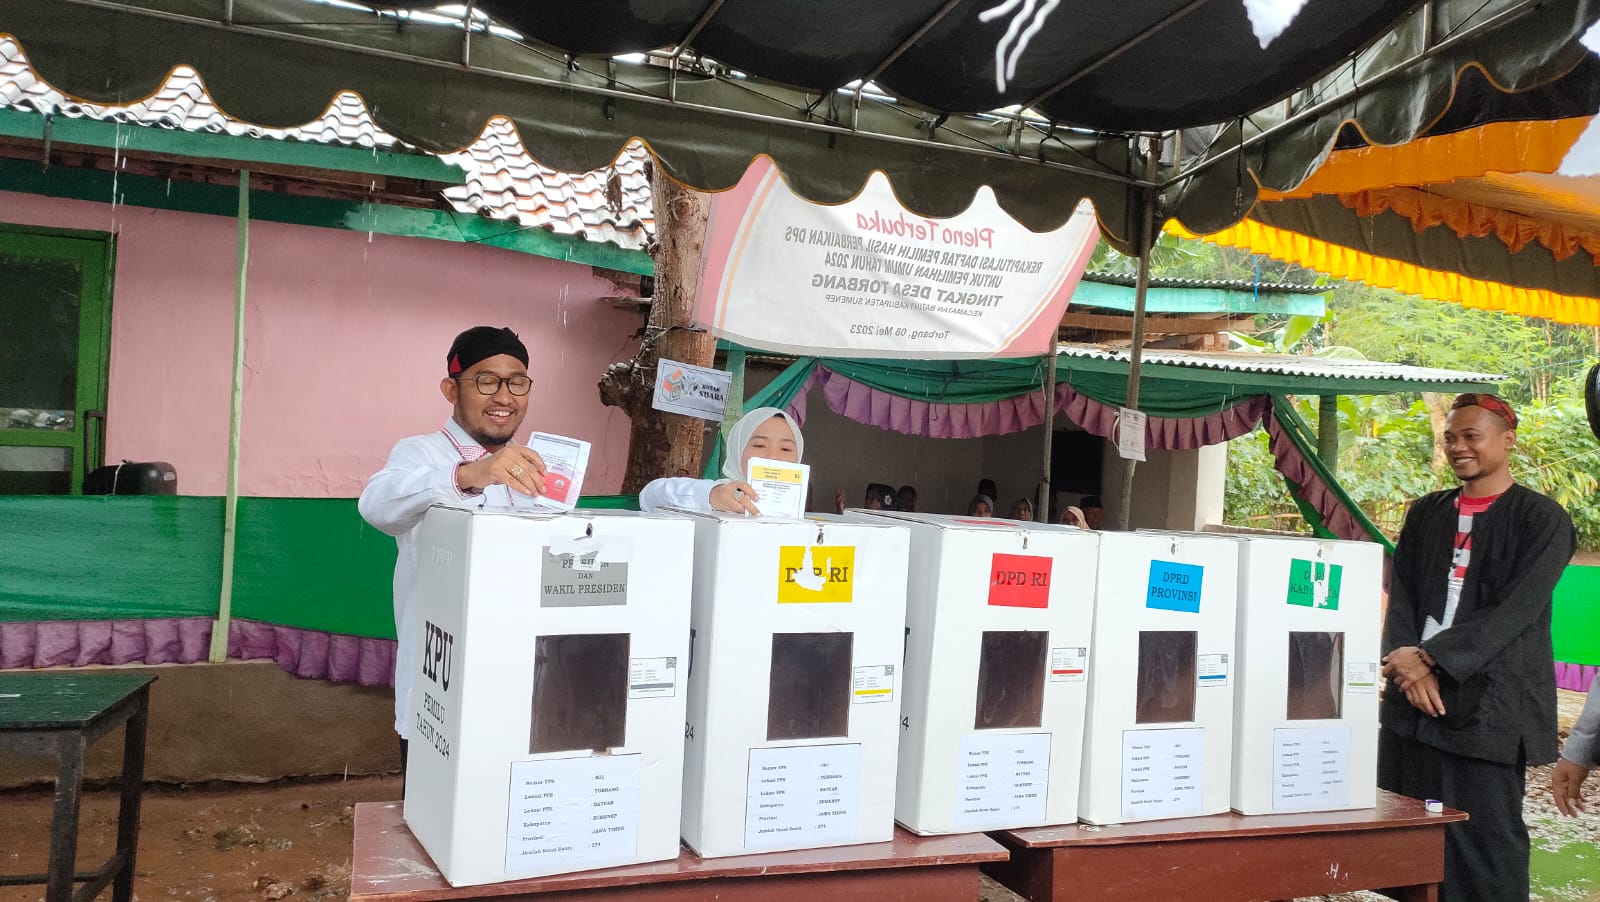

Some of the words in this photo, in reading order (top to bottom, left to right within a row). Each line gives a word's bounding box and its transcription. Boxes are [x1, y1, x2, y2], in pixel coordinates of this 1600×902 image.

[577, 572, 594, 580] DAN
[829, 566, 848, 583] RI
[995, 570, 1027, 586] DPD
[1030, 571, 1048, 587] RI
[1162, 571, 1190, 585] DPRD
[544, 584, 576, 595] WAKIL
[578, 583, 626, 594] PRESIDEN
[1151, 586, 1198, 602] PROVINSI
[423, 620, 454, 692] KPU
[423, 691, 446, 725] PEMILU
[416, 712, 435, 745] TAHUN
[434, 738, 451, 761] 2024
